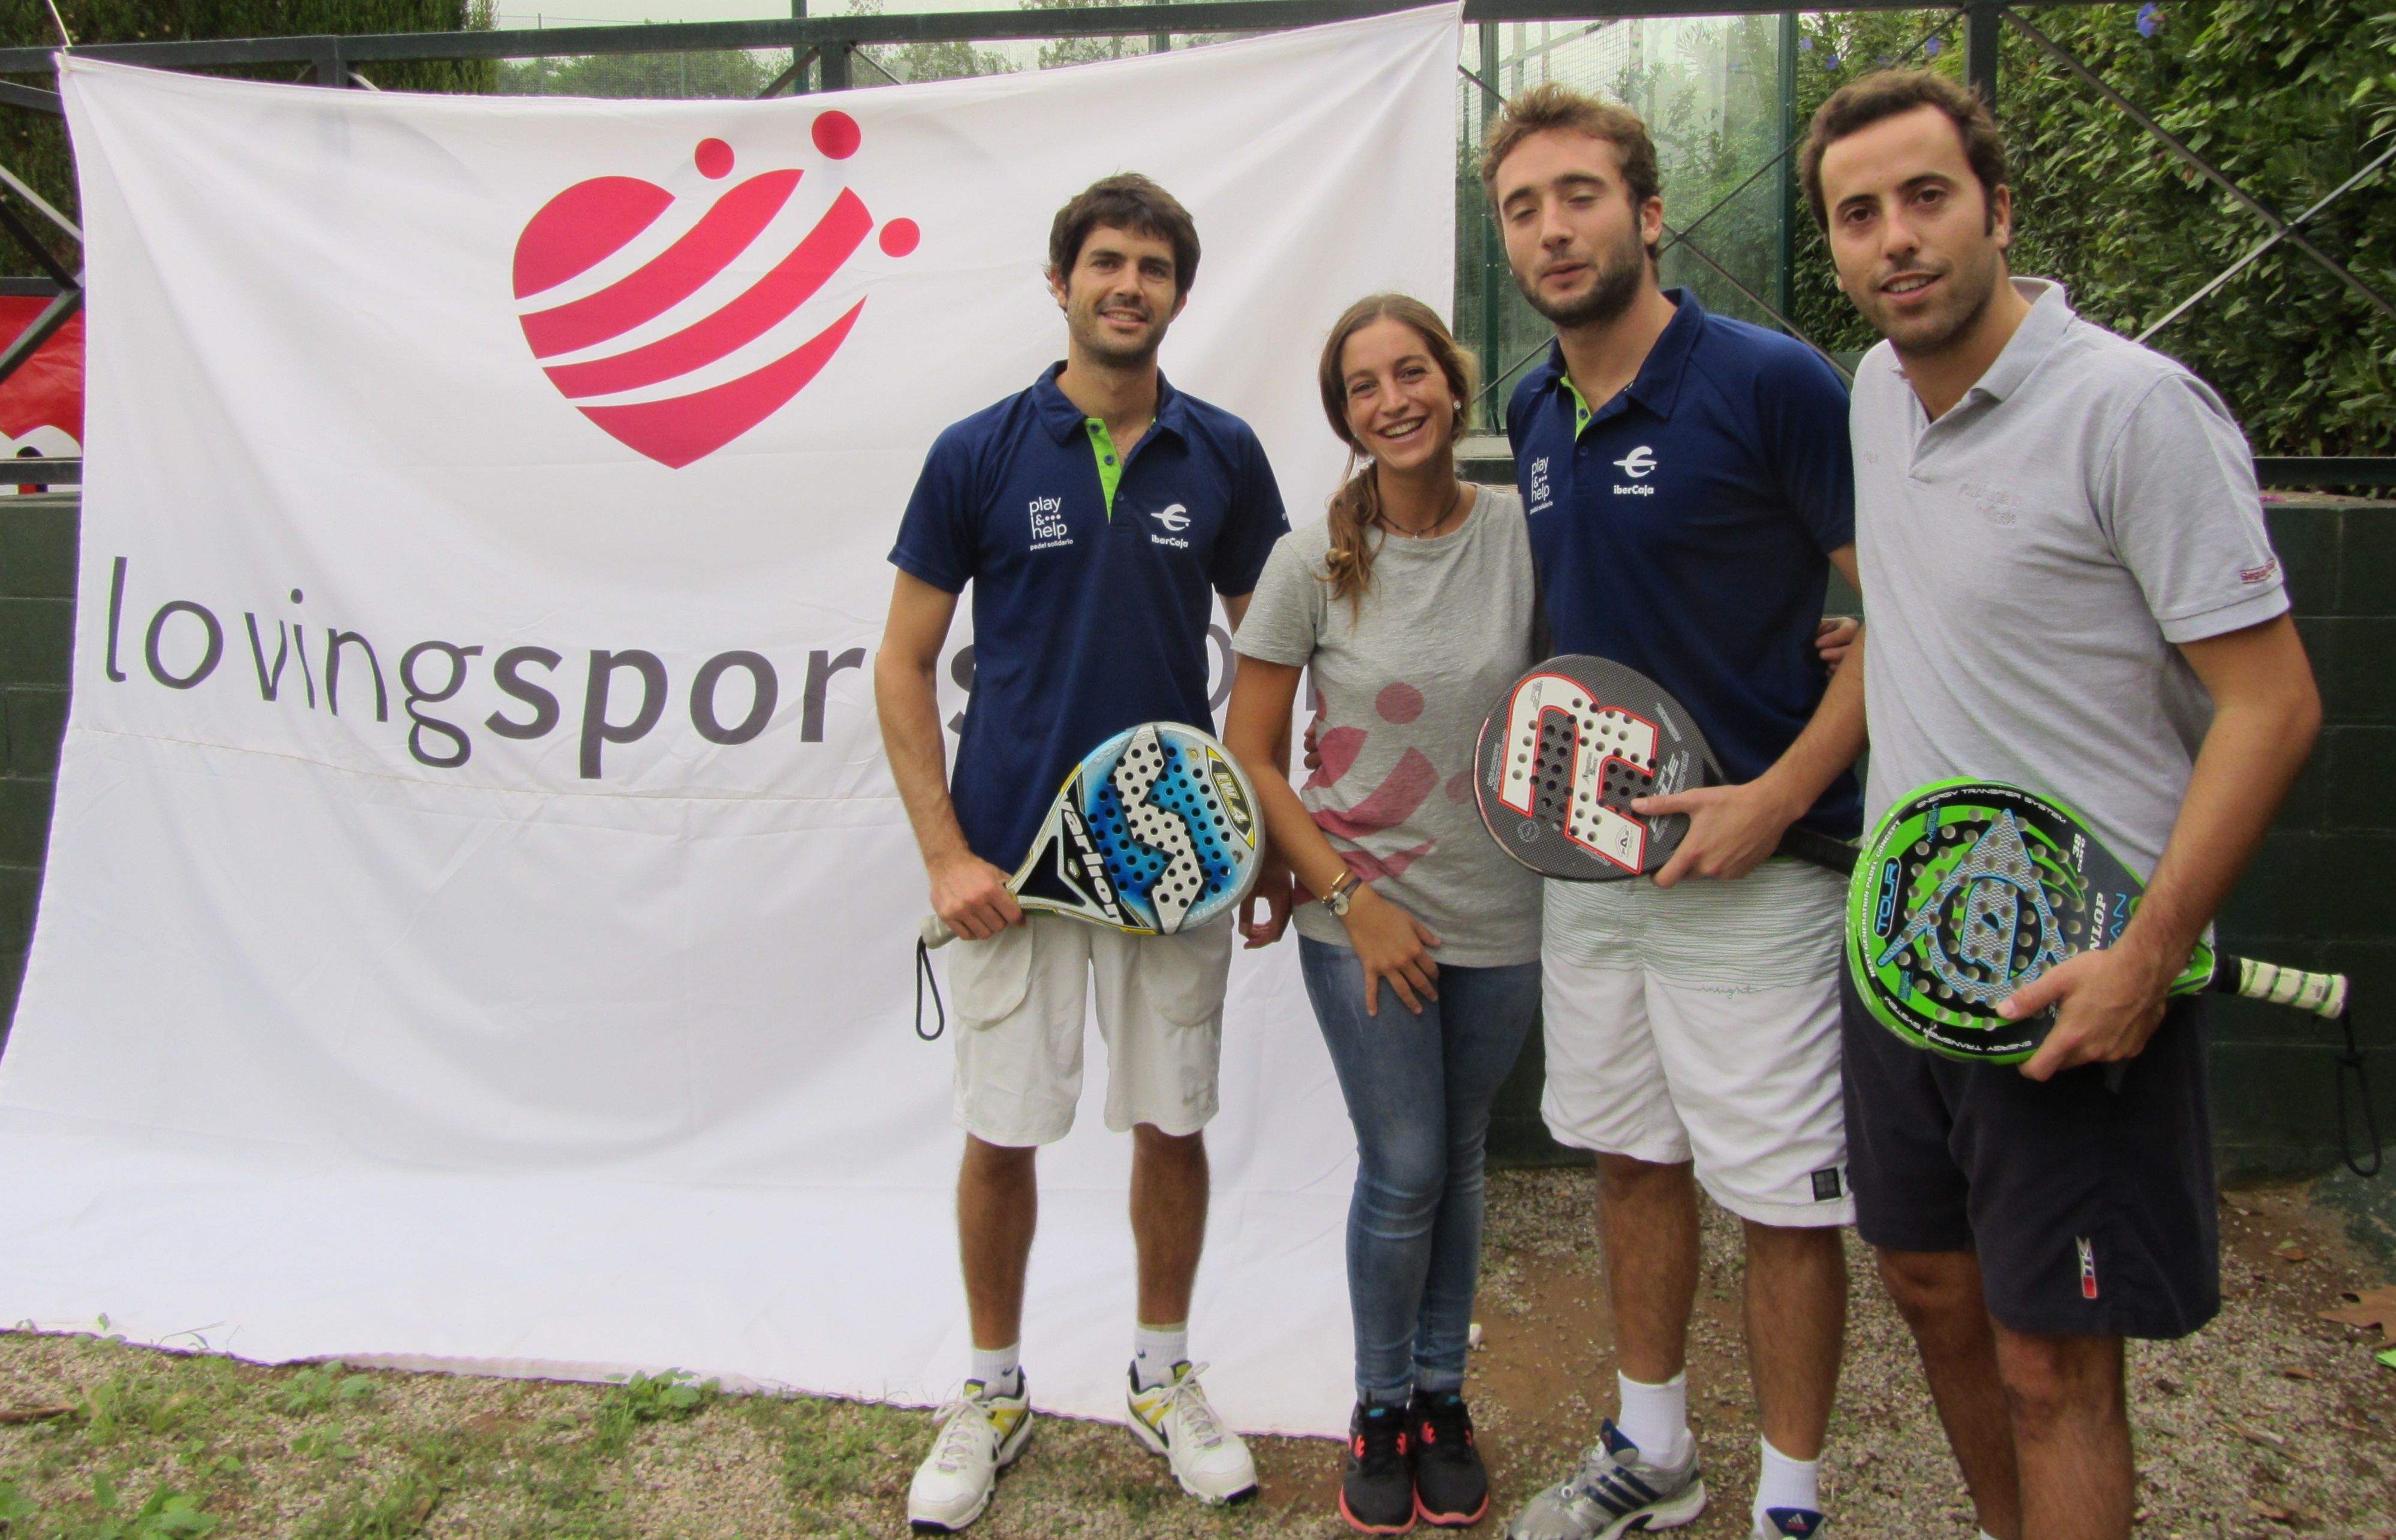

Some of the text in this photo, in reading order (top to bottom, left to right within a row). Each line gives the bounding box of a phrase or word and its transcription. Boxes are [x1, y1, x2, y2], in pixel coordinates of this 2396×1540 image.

[1532, 456, 1549, 479] play
[1029, 496, 1062, 517] play
[1531, 483, 1550, 503] help
[1030, 517, 1068, 540] help
[1030, 542, 1047, 551] padel
[106, 555, 976, 779] lovingspor
[1916, 788, 2067, 824] ENERGY TRANSFER SYSTEM
[1876, 819, 1901, 858] CONCEPT
[1865, 859, 1879, 888] PADEL
[1876, 863, 1898, 933] TOUR
[1861, 890, 1870, 950] GENERATION
[2088, 892, 2106, 951] NLOP
[1986, 1040, 2033, 1051] ENERGY
